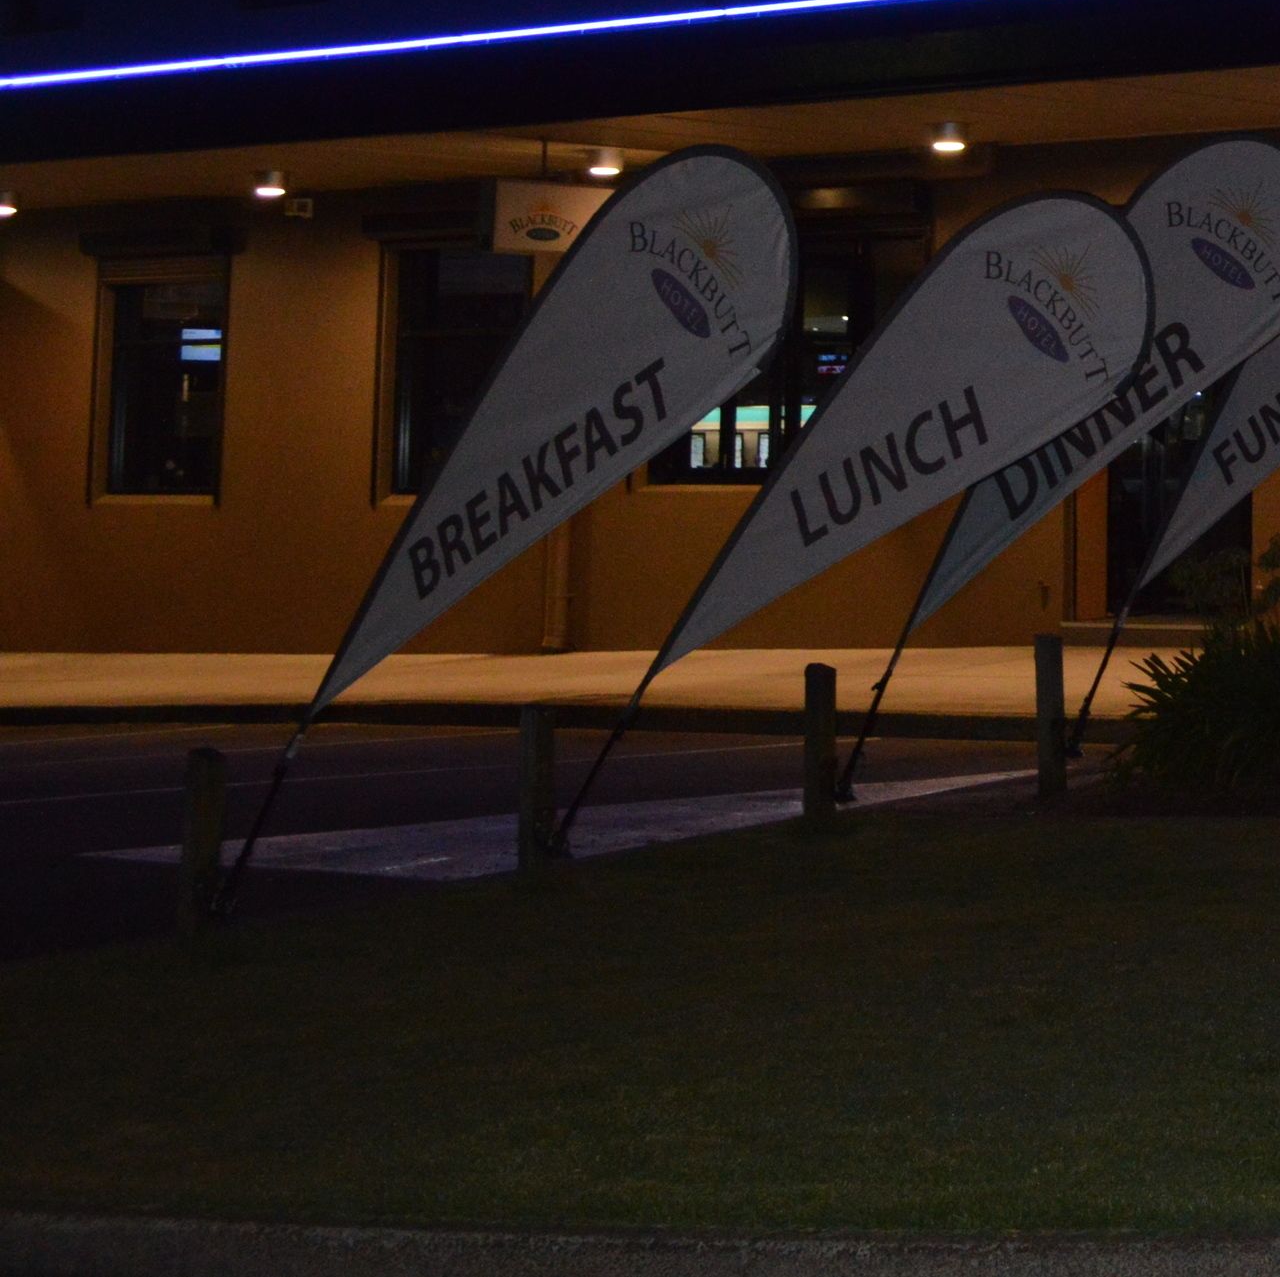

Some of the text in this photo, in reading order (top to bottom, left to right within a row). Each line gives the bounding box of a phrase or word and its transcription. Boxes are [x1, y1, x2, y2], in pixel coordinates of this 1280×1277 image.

[629, 221, 752, 356] BLACKBUTT
[660, 277, 700, 332] HOTEL
[984, 250, 1109, 382] BLACKBUTT
[1017, 304, 1060, 357] HOTEL
[1202, 244, 1243, 285] HOTEL
[407, 357, 671, 600] BREAKFAST
[787, 384, 990, 549] LUNCH
